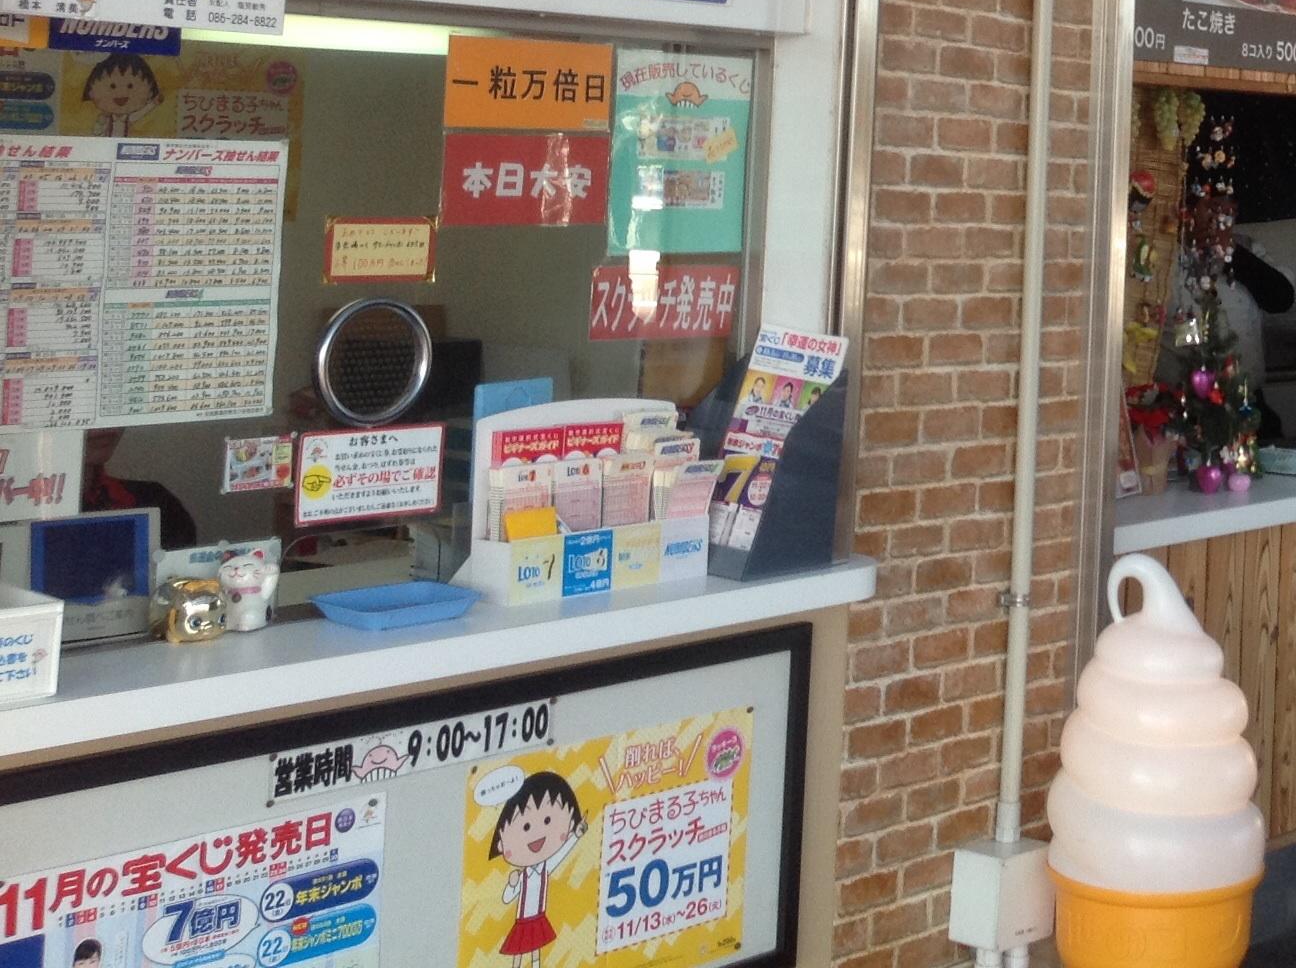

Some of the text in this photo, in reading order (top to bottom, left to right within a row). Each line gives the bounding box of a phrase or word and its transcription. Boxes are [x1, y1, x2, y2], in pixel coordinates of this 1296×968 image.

[1182, 8, 1237, 35] たこ焼き
[452, 65, 606, 104] 一粒万倍日
[461, 162, 593, 199] 本日大安
[591, 274, 736, 331] スクチ発売中
[518, 566, 541, 582] LOTO
[274, 744, 354, 798] 営業時間
[609, 786, 727, 835] ちびまる子ちゃん
[606, 816, 705, 867] スクラッチ
[0, 811, 333, 938] 11月の宝くじ発売日
[605, 854, 724, 918] 50万円
[163, 898, 242, 944] 7億円
